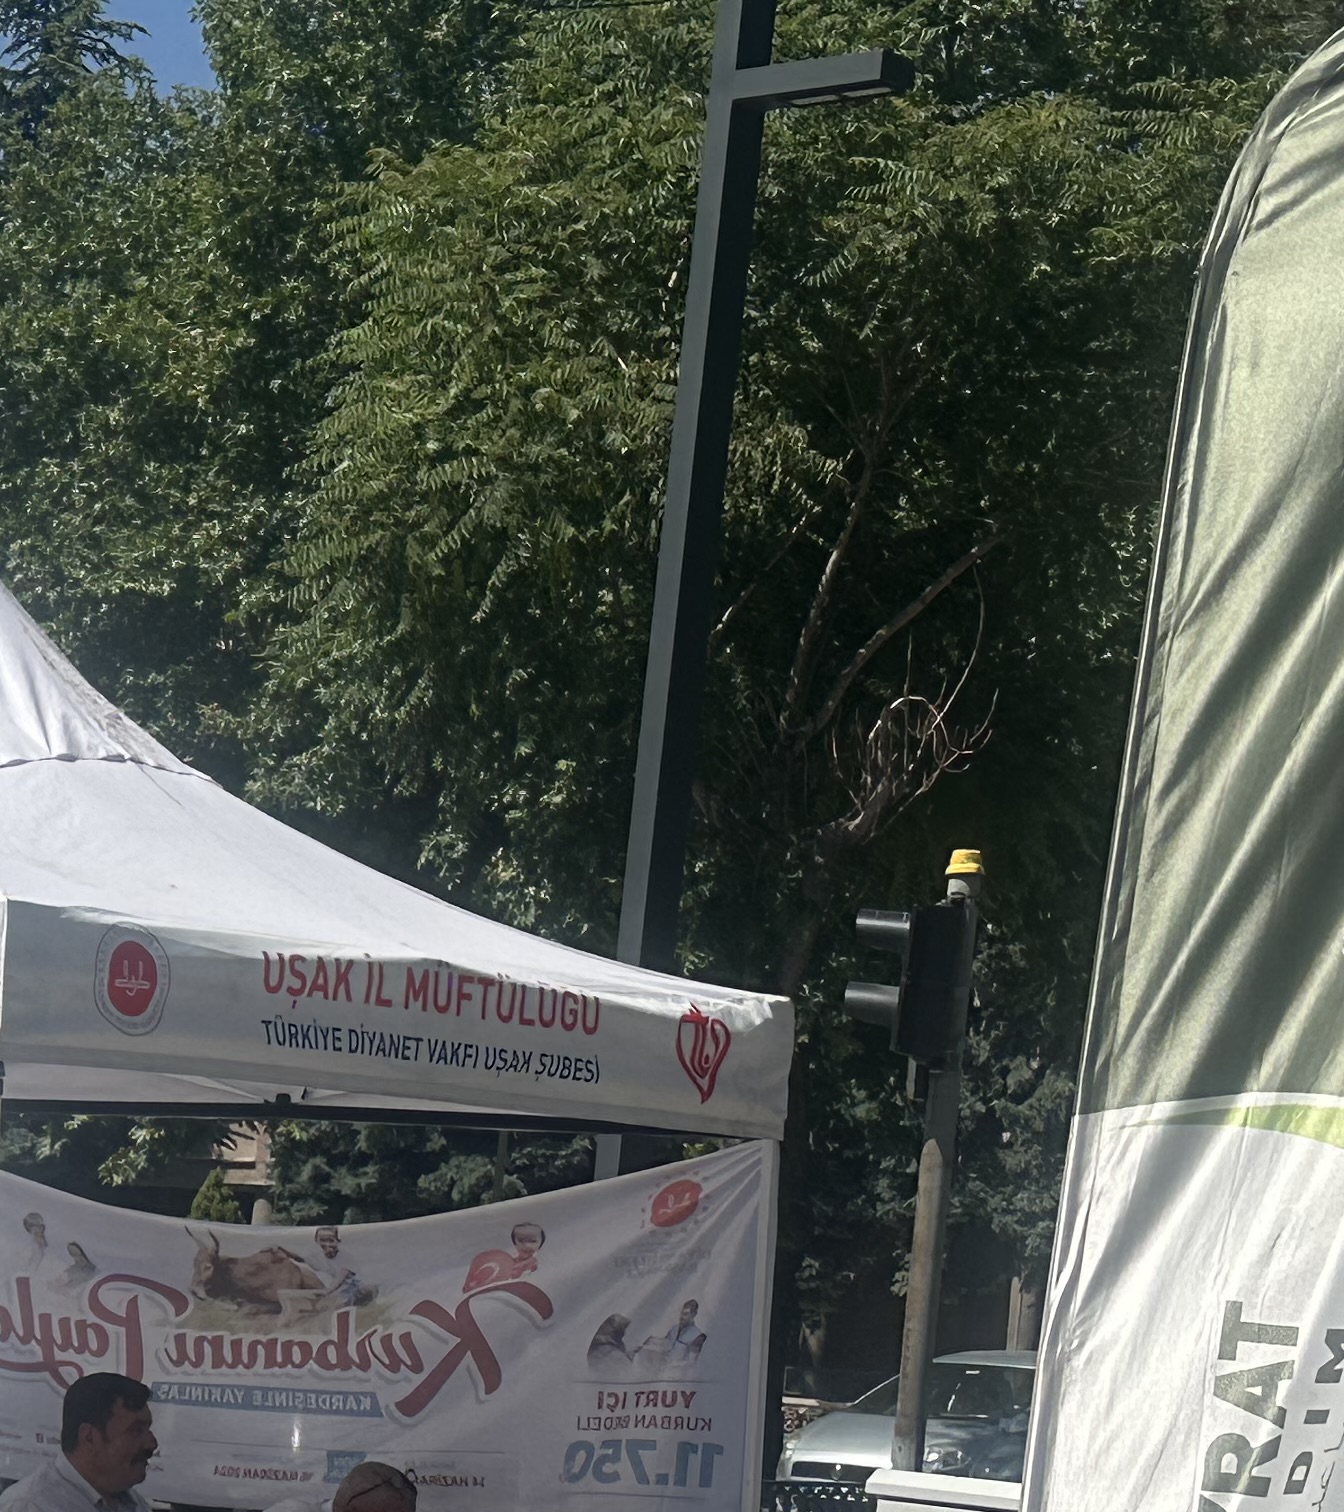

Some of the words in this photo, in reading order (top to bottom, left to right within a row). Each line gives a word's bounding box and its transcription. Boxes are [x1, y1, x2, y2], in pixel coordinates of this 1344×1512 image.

[261, 950, 355, 1010] UŞAK
[260, 1013, 343, 1053] TÜRKİYE
[347, 1023, 424, 1062] DİYANET
[427, 1038, 480, 1070] VAKFI
[484, 1045, 533, 1079] UŞAK
[534, 1051, 601, 1085] ŞUBESİ
